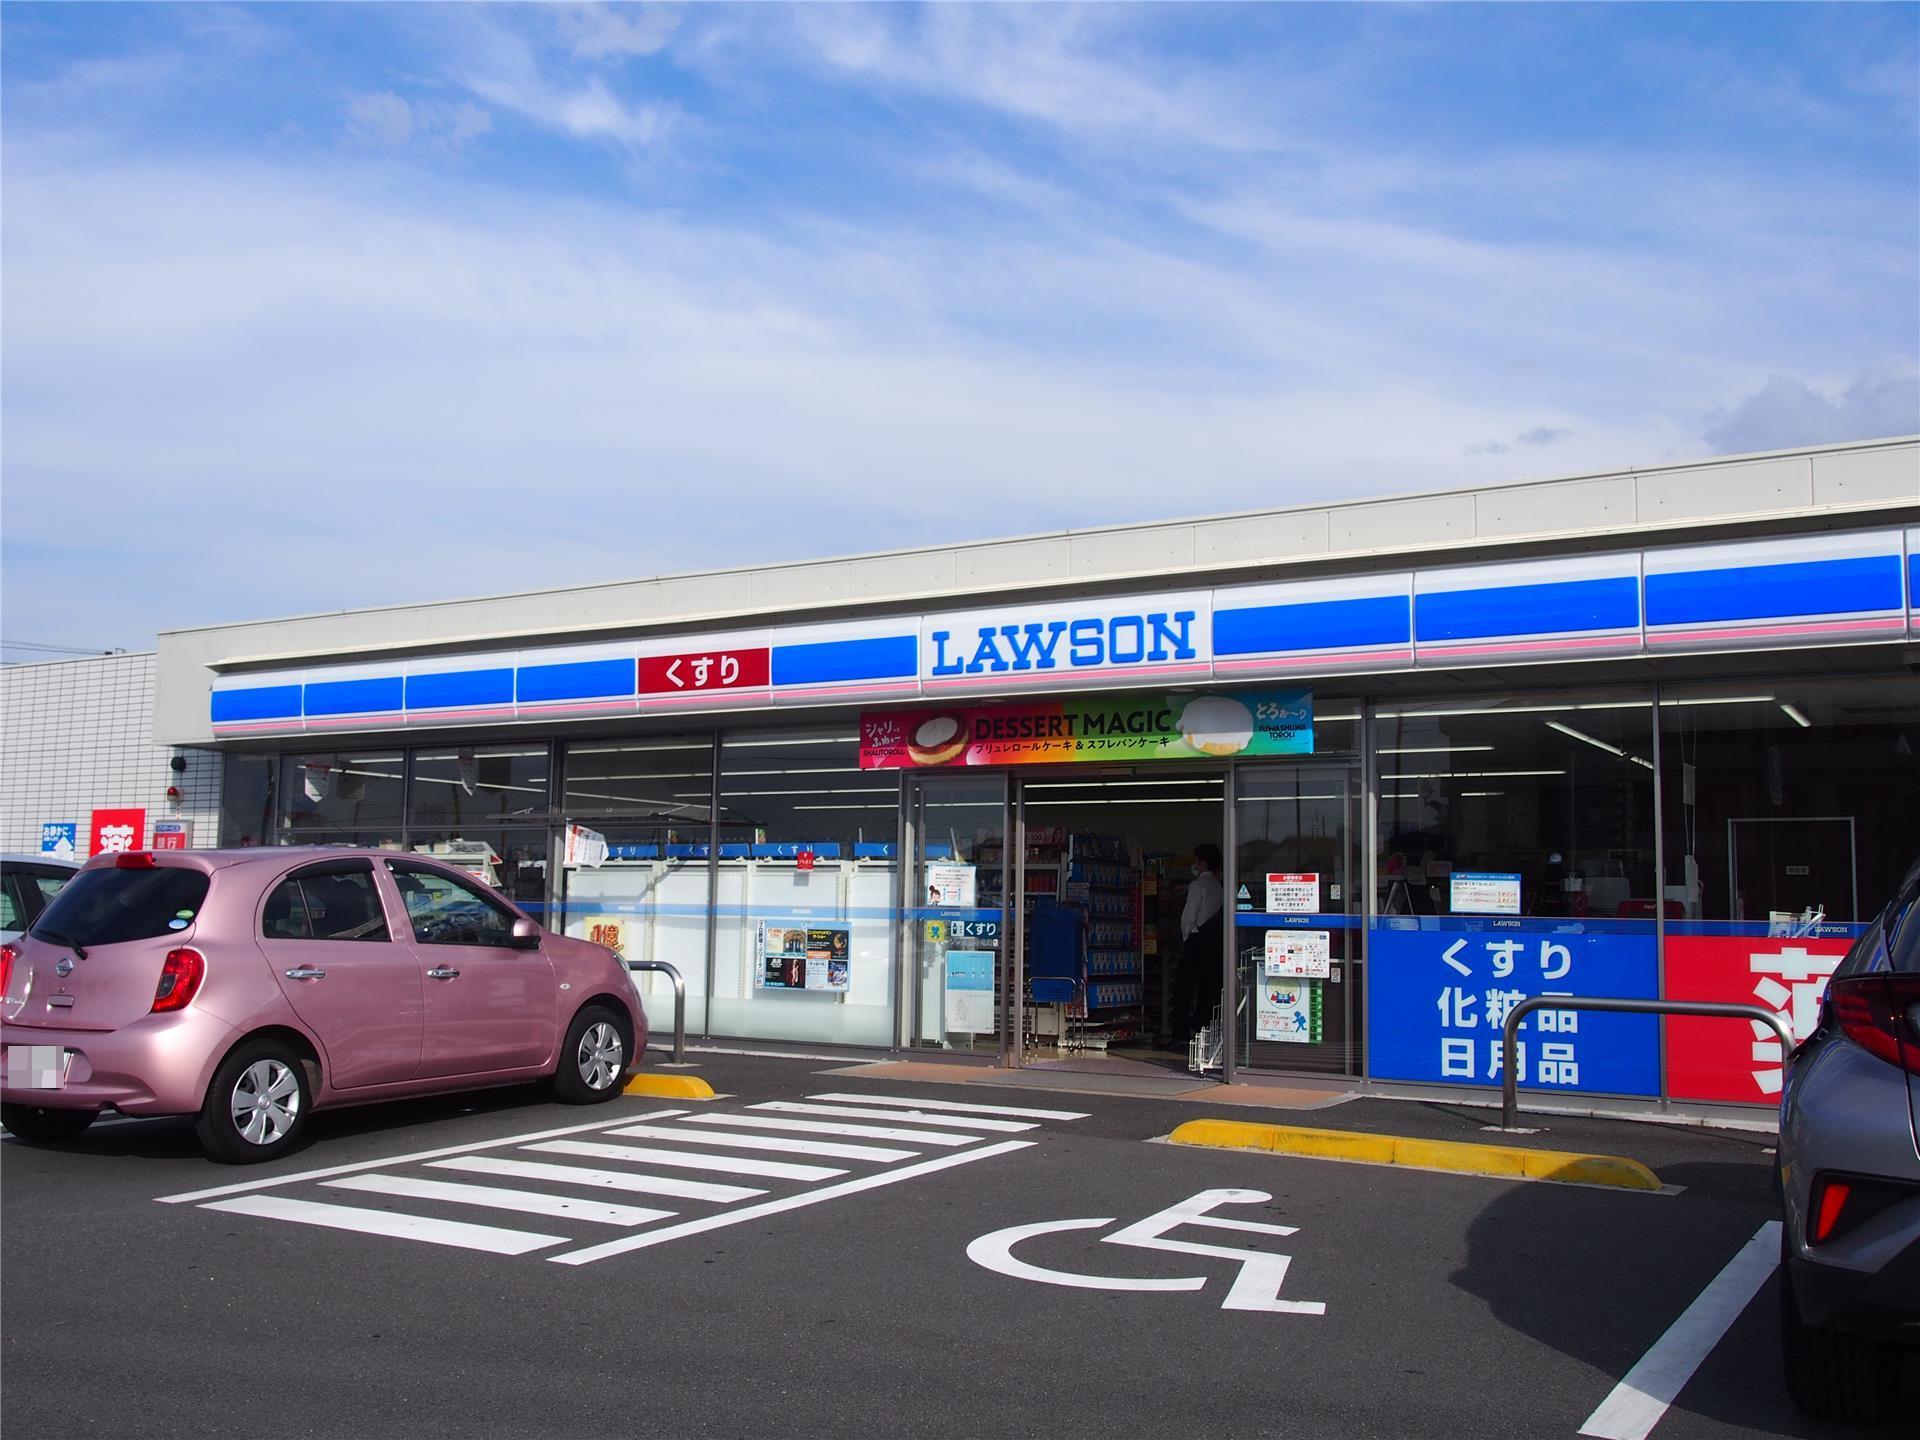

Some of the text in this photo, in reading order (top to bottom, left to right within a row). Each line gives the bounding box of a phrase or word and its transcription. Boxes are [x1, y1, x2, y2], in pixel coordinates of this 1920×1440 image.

[932, 611, 1196, 676] LAWSON
[665, 655, 740, 688] くすり
[976, 709, 1172, 740] DESSERT MAGIC
[1075, 741, 1084, 750] &
[966, 922, 997, 936] くすり
[1441, 938, 1572, 981] くすり
[1436, 986, 1579, 1034] 化粧品
[1440, 1037, 1579, 1086] 日用品
